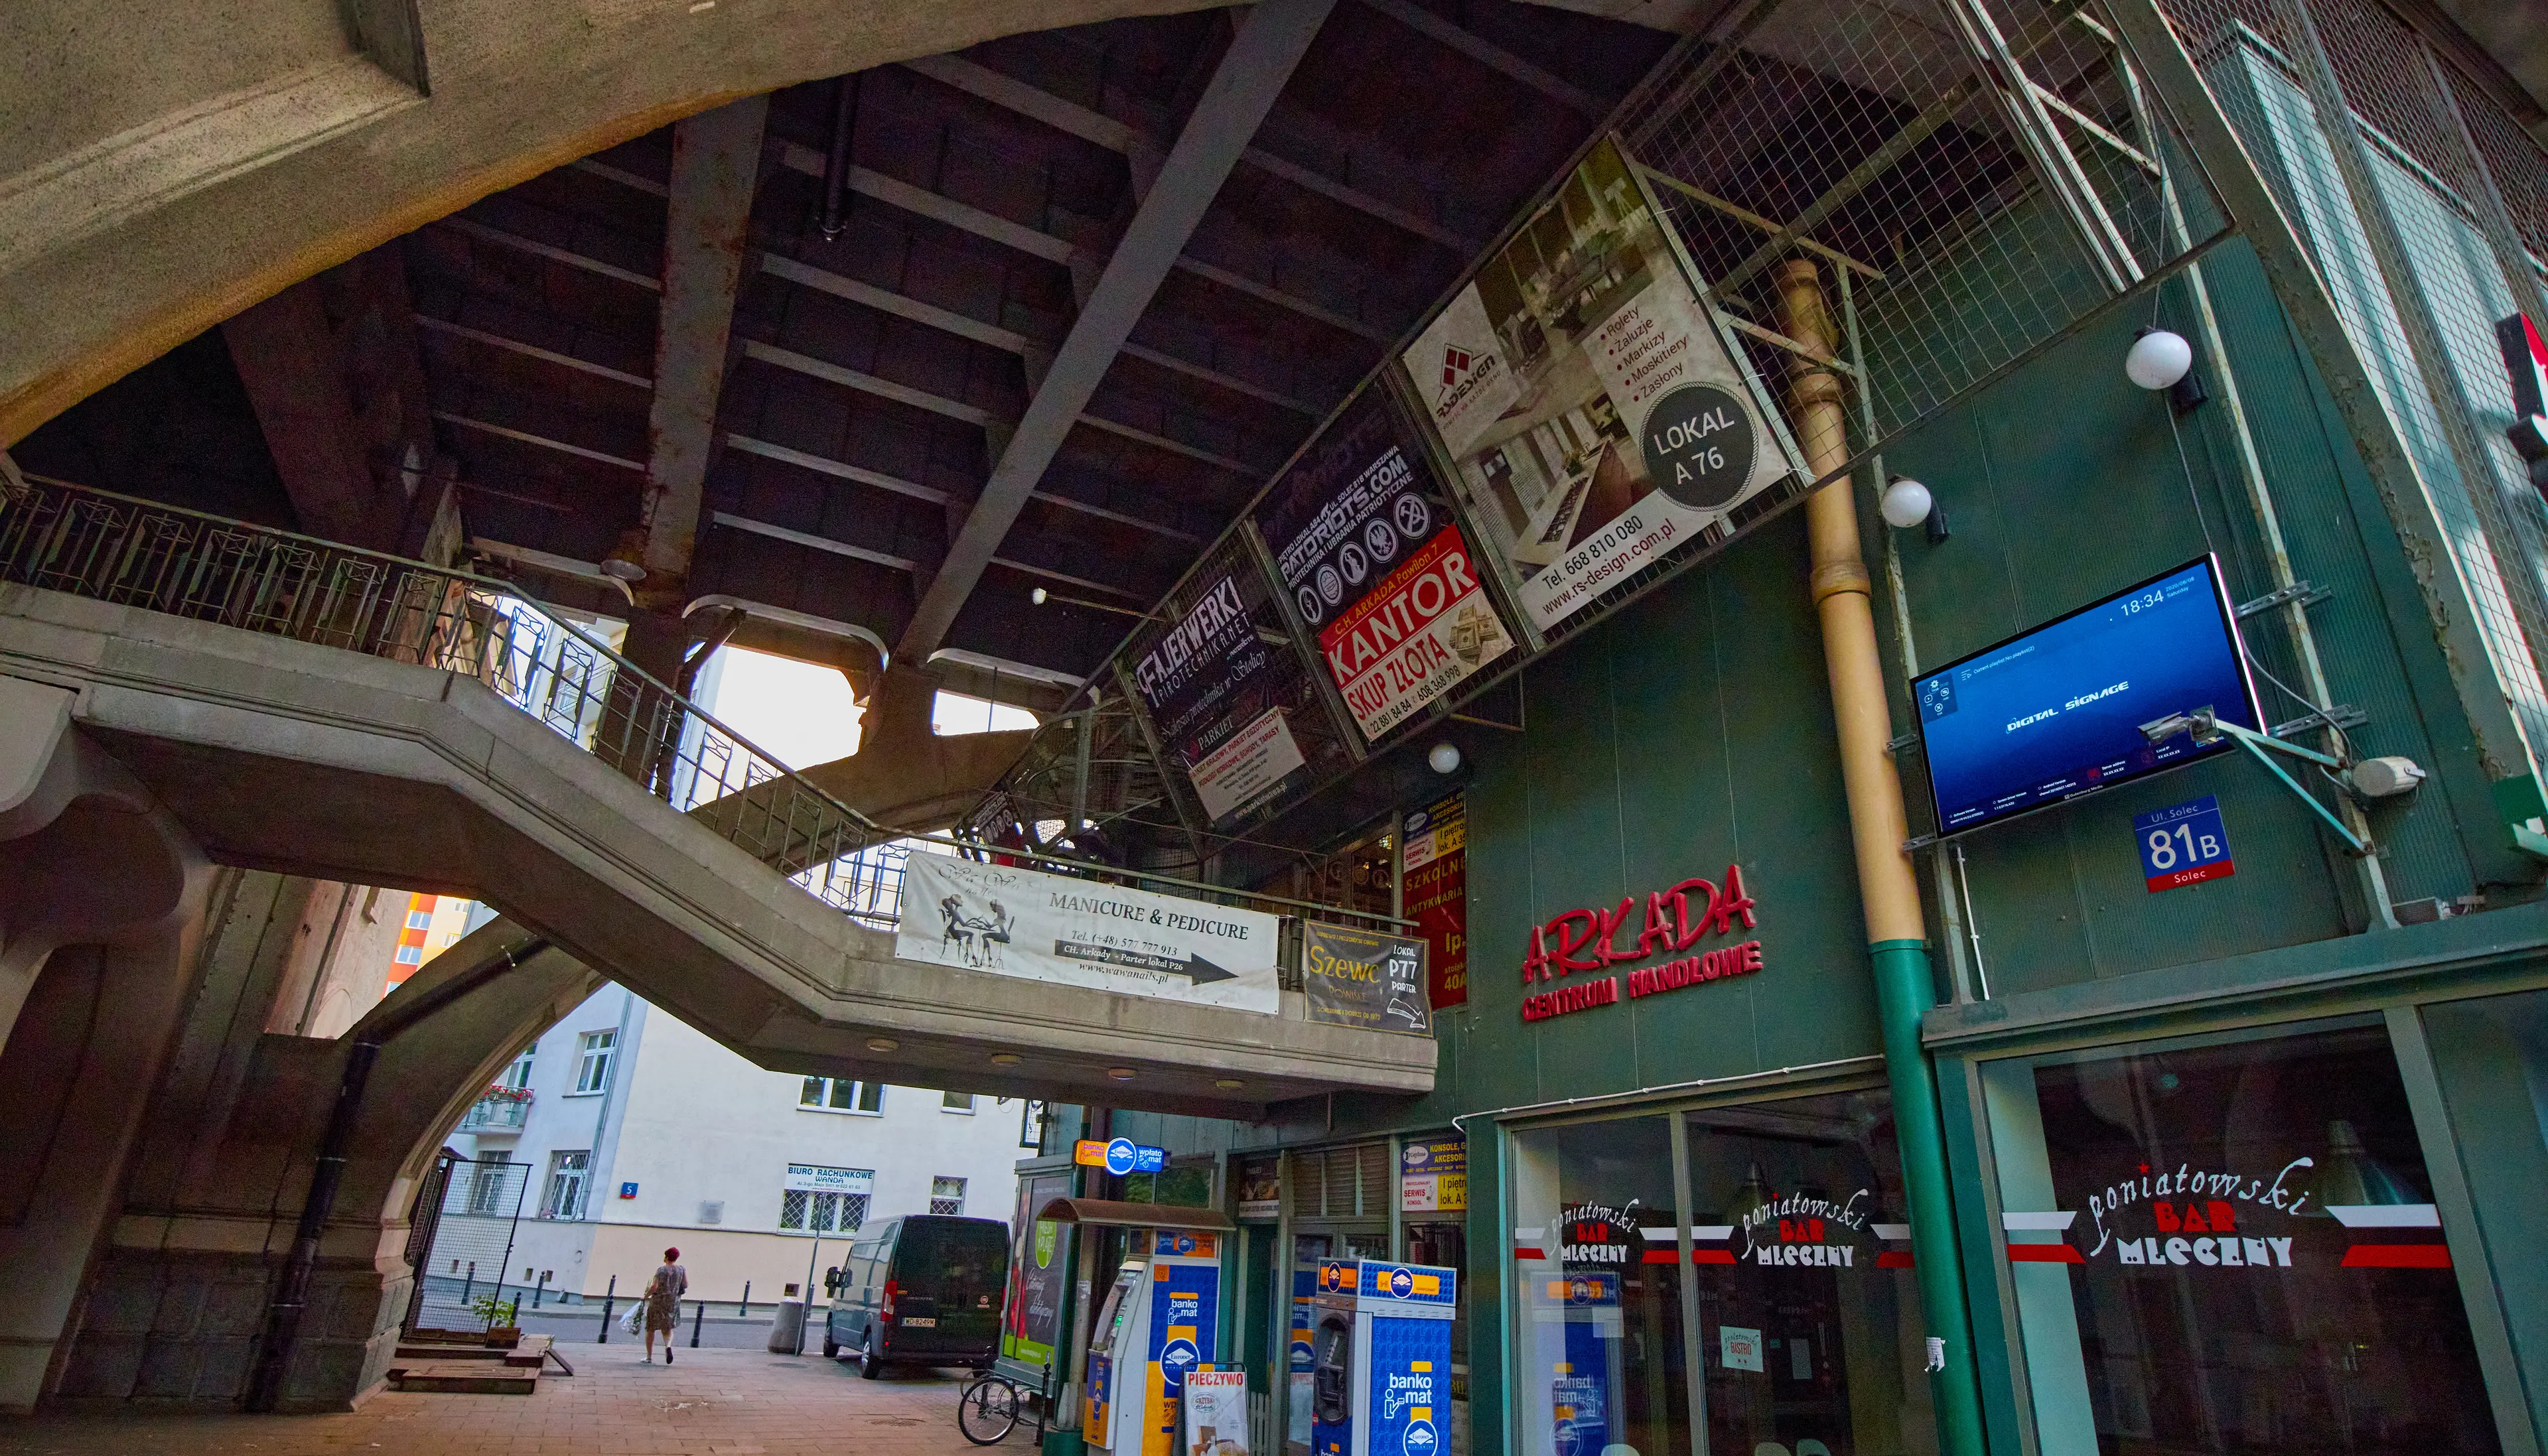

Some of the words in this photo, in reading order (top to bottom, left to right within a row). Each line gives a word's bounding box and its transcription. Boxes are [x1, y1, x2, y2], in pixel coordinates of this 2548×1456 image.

[1606, 306, 1640, 336] Rolety
[1614, 318, 1654, 353] Żaluzje
[1622, 332, 1667, 367] Markizy
[1631, 336, 1689, 383] Moskitiery
[1640, 362, 1684, 399] Zasłony
[1654, 407, 1735, 455] LOKAL
[1675, 462, 1693, 485] A
[1691, 446, 1724, 475] 76
[1294, 528, 1311, 547] LOKAL
[1337, 486, 1354, 502] SOLEC
[1363, 445, 1399, 478] WARSZAWA
[1288, 552, 1326, 591] PIROTECHNIKA
[1326, 519, 1358, 551] UBRANIA
[1356, 472, 1413, 525] PATRIOTYCZNE
[1542, 569, 1566, 590] Tel.
[1565, 551, 1590, 575] 668
[1589, 534, 1616, 559] 810
[1615, 515, 1643, 540] 080
[1542, 518, 1676, 615] www.rs-design.com.pl
[1334, 617, 1355, 635] C.H.
[1355, 581, 1397, 620] ARKADA
[1431, 543, 1439, 555] 7
[2121, 590, 2164, 616] 18:34
[2165, 576, 2195, 592] 2020/08/08
[2166, 586, 2190, 598] Saturday
[1328, 552, 1475, 685] KANTOR
[1136, 576, 1243, 708] FAJERWERKI
[1231, 650, 1266, 681] Stolicy
[1348, 671, 1389, 721] SKUP
[1385, 632, 1451, 695] ZŁOTA
[1973, 664, 1989, 675] Current
[1370, 718, 1381, 733] 22
[1379, 710, 1394, 728] 881
[1392, 704, 1402, 720] 84
[1400, 698, 1412, 712] 84
[1417, 684, 1435, 702] 608
[1430, 675, 1448, 695] 368
[1445, 665, 1461, 682] 998
[1198, 715, 1234, 750] PARKIET
[1228, 734, 1247, 754] PARKIET
[1247, 709, 1280, 738] EGZOTYCZNY
[1259, 726, 1280, 744] TARASY
[2007, 709, 2058, 732] DIGITAL
[2151, 813, 2167, 823] Ul.
[2169, 805, 2198, 818] Solec
[1405, 847, 1425, 861] SERWIS
[1438, 842, 1451, 854] lok.
[1451, 838, 1456, 846] A
[2174, 870, 2206, 884] Solec
[1049, 892, 1145, 922] MANICURE
[1149, 909, 1162, 925] &
[1167, 913, 1249, 941] PEDICURE
[1522, 864, 1756, 982] ARKADA
[1064, 944, 1078, 955] CH.
[1081, 946, 1111, 960] Arkady
[1120, 953, 1147, 965] Parter
[1148, 957, 1168, 968] lokal
[1168, 961, 1184, 971] P26
[1072, 930, 1088, 941] Tel.
[1092, 932, 1119, 948] (+48)
[1121, 938, 1139, 949] 577
[1142, 941, 1159, 953] 777
[1161, 945, 1178, 957] 913
[1393, 944, 1415, 957] LOKAL
[1078, 962, 1169, 984] www.wawanails.pl
[1310, 945, 1381, 984] Szewc
[1389, 959, 1418, 980] P77
[1445, 962, 1466, 974] stoisk
[1391, 981, 1417, 994] PARTER
[1522, 976, 1619, 1022] CENTRUM
[1628, 940, 1764, 999] HANDLOWE
[1430, 1143, 1460, 1153] KONSOLE,
[788, 1167, 813, 1175] BIURO
[817, 1169, 873, 1179] RACHUNKOWE
[626, 1185, 632, 1194] 5
[1441, 1194, 1453, 1205] lok.
[1455, 1193, 1462, 1204] A
[2089, 1156, 2314, 1257] poniatowski
[2153, 1200, 2237, 1232] BAR
[1549, 1198, 1639, 1256] poniatowski
[1577, 1223, 1608, 1242] BAR
[1741, 1189, 1869, 1260] poniatowski
[1779, 1219, 1824, 1242] BAR
[1171, 1299, 1198, 1308] banko
[1731, 1341, 1752, 1355] BISTRO
[1188, 1373, 1243, 1386] PIECZYWO
[1389, 1372, 1432, 1389] banko
[1405, 1390, 1432, 1404] mat
